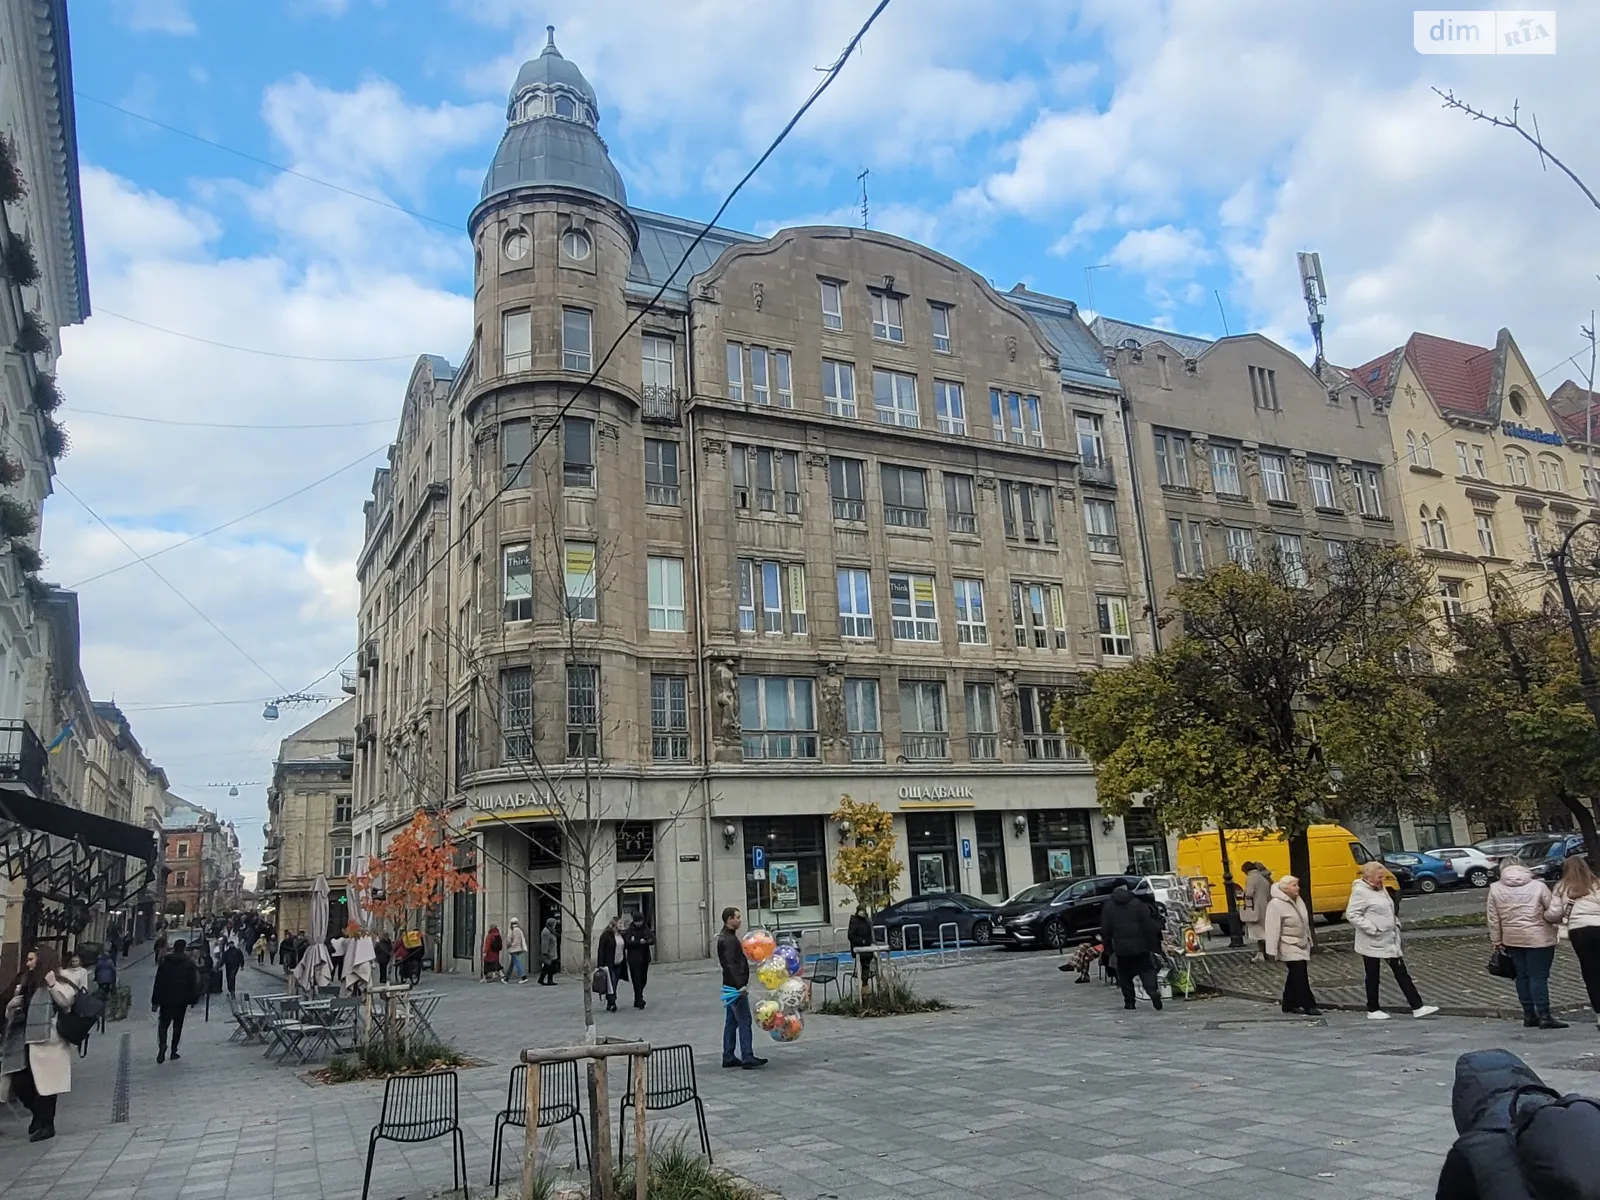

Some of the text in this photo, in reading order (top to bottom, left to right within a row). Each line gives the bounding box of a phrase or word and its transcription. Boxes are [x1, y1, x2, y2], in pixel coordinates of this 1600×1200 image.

[508, 555, 531, 567] Think
[890, 582, 908, 592] Think
[899, 786, 974, 801] ОЩАДБАНК
[963, 840, 970, 857] P
[755, 848, 763, 867] P
